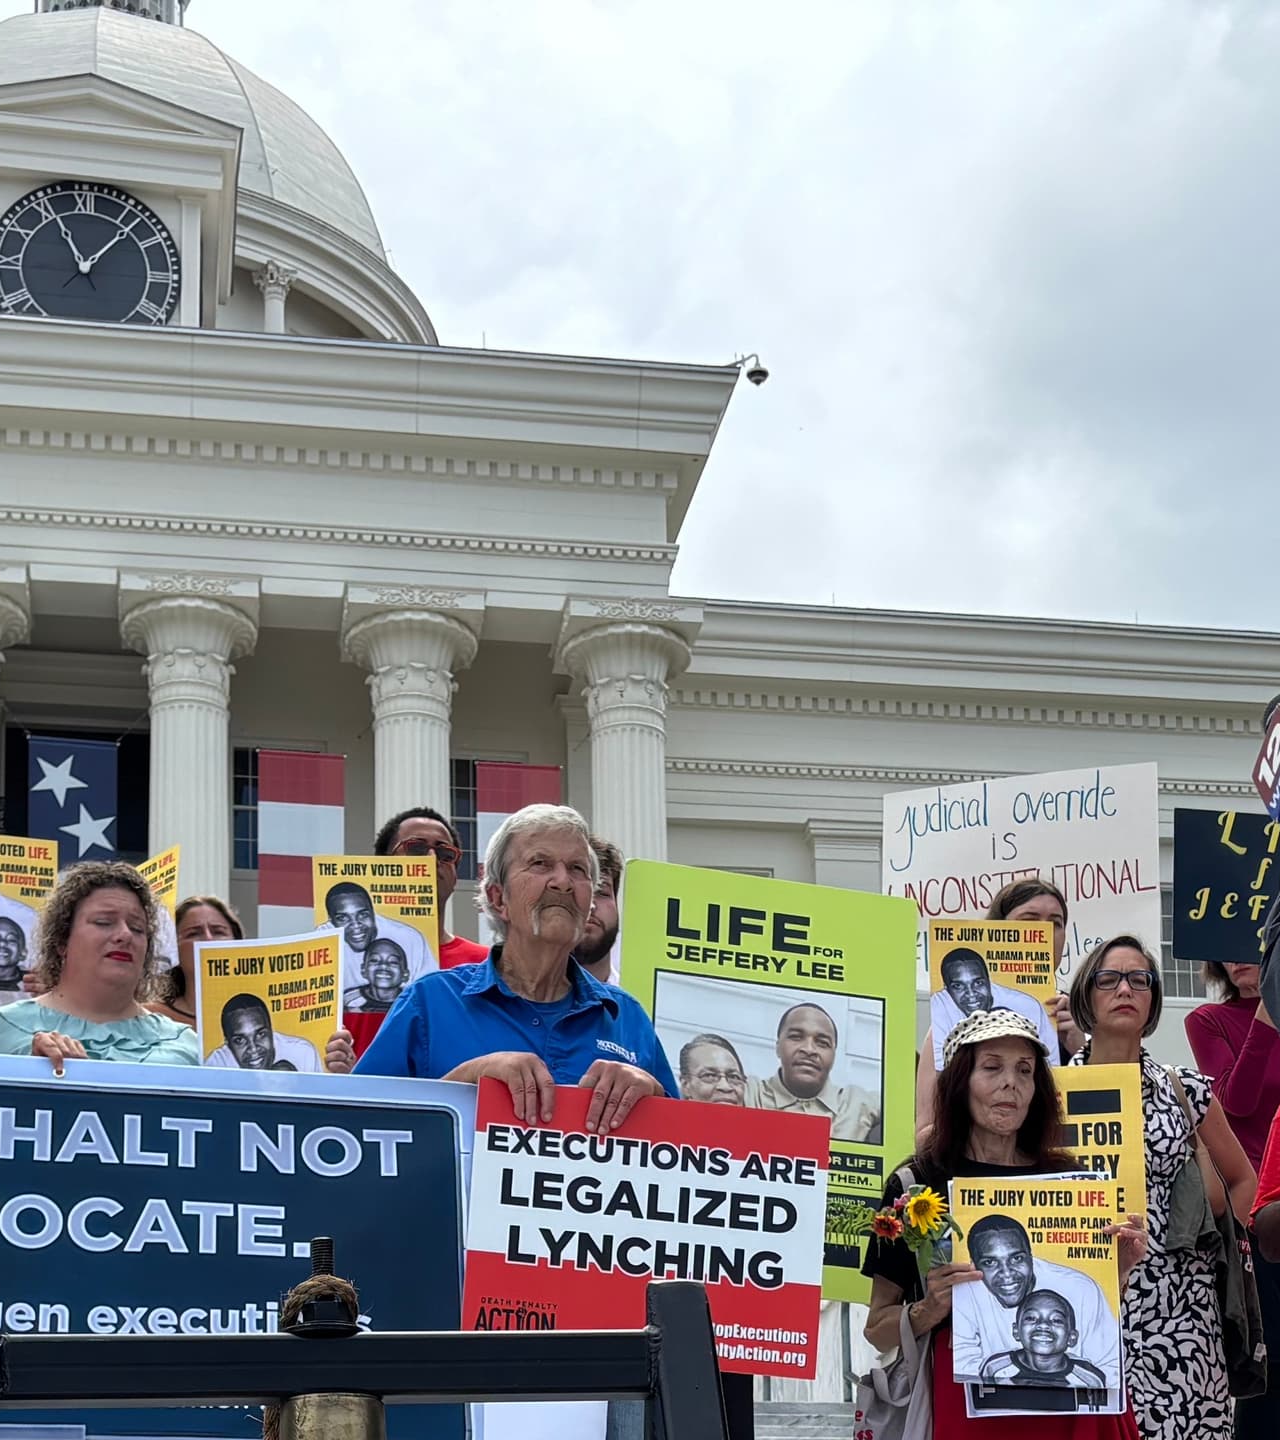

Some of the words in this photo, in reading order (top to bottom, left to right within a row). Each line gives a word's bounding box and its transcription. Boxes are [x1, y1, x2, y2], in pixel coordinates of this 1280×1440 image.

[889, 782, 990, 872] judicial
[1012, 769, 1117, 824] override
[28, 846, 52, 860] LIFE.
[991, 832, 1018, 861] is
[319, 863, 337, 876] THE
[341, 864, 367, 876] JURY
[371, 864, 403, 876] VOTED
[407, 865, 431, 877] LIFE.
[370, 884, 406, 893] ALABAMA
[666, 897, 811, 955] LIFE
[814, 947, 843, 959] FOR
[935, 928, 953, 941] THE
[957, 928, 983, 941] JURY
[988, 929, 1019, 942] VOTED
[1024, 930, 1047, 943] LIFE.
[207, 959, 230, 976] THE
[234, 957, 265, 975] JURY
[269, 953, 304, 972] VOTED
[308, 948, 333, 967] LIFE.
[666, 943, 787, 974] JEFFERY
[796, 960, 844, 981] LEE
[986, 951, 1023, 960] ALABAMA
[989, 963, 997, 972] TO
[1000, 963, 1032, 972] EXECUTE
[268, 979, 307, 997] ALABAMA
[310, 975, 334, 990] PLANS
[271, 1000, 281, 1012] TO
[284, 993, 316, 1010] EXECUTE
[300, 1005, 333, 1023] ANYWAY.
[1082, 1122, 1122, 1146] FOR
[239, 1121, 413, 1179] NOT
[487, 1125, 730, 1176] EXECUTIONS
[739, 1153, 816, 1186] ARE
[846, 1158, 876, 1169] LIFE
[500, 1168, 798, 1234] LEGALIZED
[960, 1189, 984, 1205] THE
[989, 1190, 1024, 1206] JURY
[1030, 1190, 1072, 1206] VOTED
[1078, 1191, 1109, 1207] LIFE.
[1028, 1217, 1076, 1228] ALABAMA
[1031, 1232, 1042, 1243] TO
[1047, 1232, 1089, 1243] EXECUTE
[1092, 1232, 1112, 1244] HIM
[506, 1225, 784, 1289] LYNCHING
[1068, 1247, 1112, 1259] ANYWAY.
[481, 1297, 511, 1305] DEATH
[516, 1300, 558, 1309] PENALTY
[87, 1300, 372, 1335] executis
